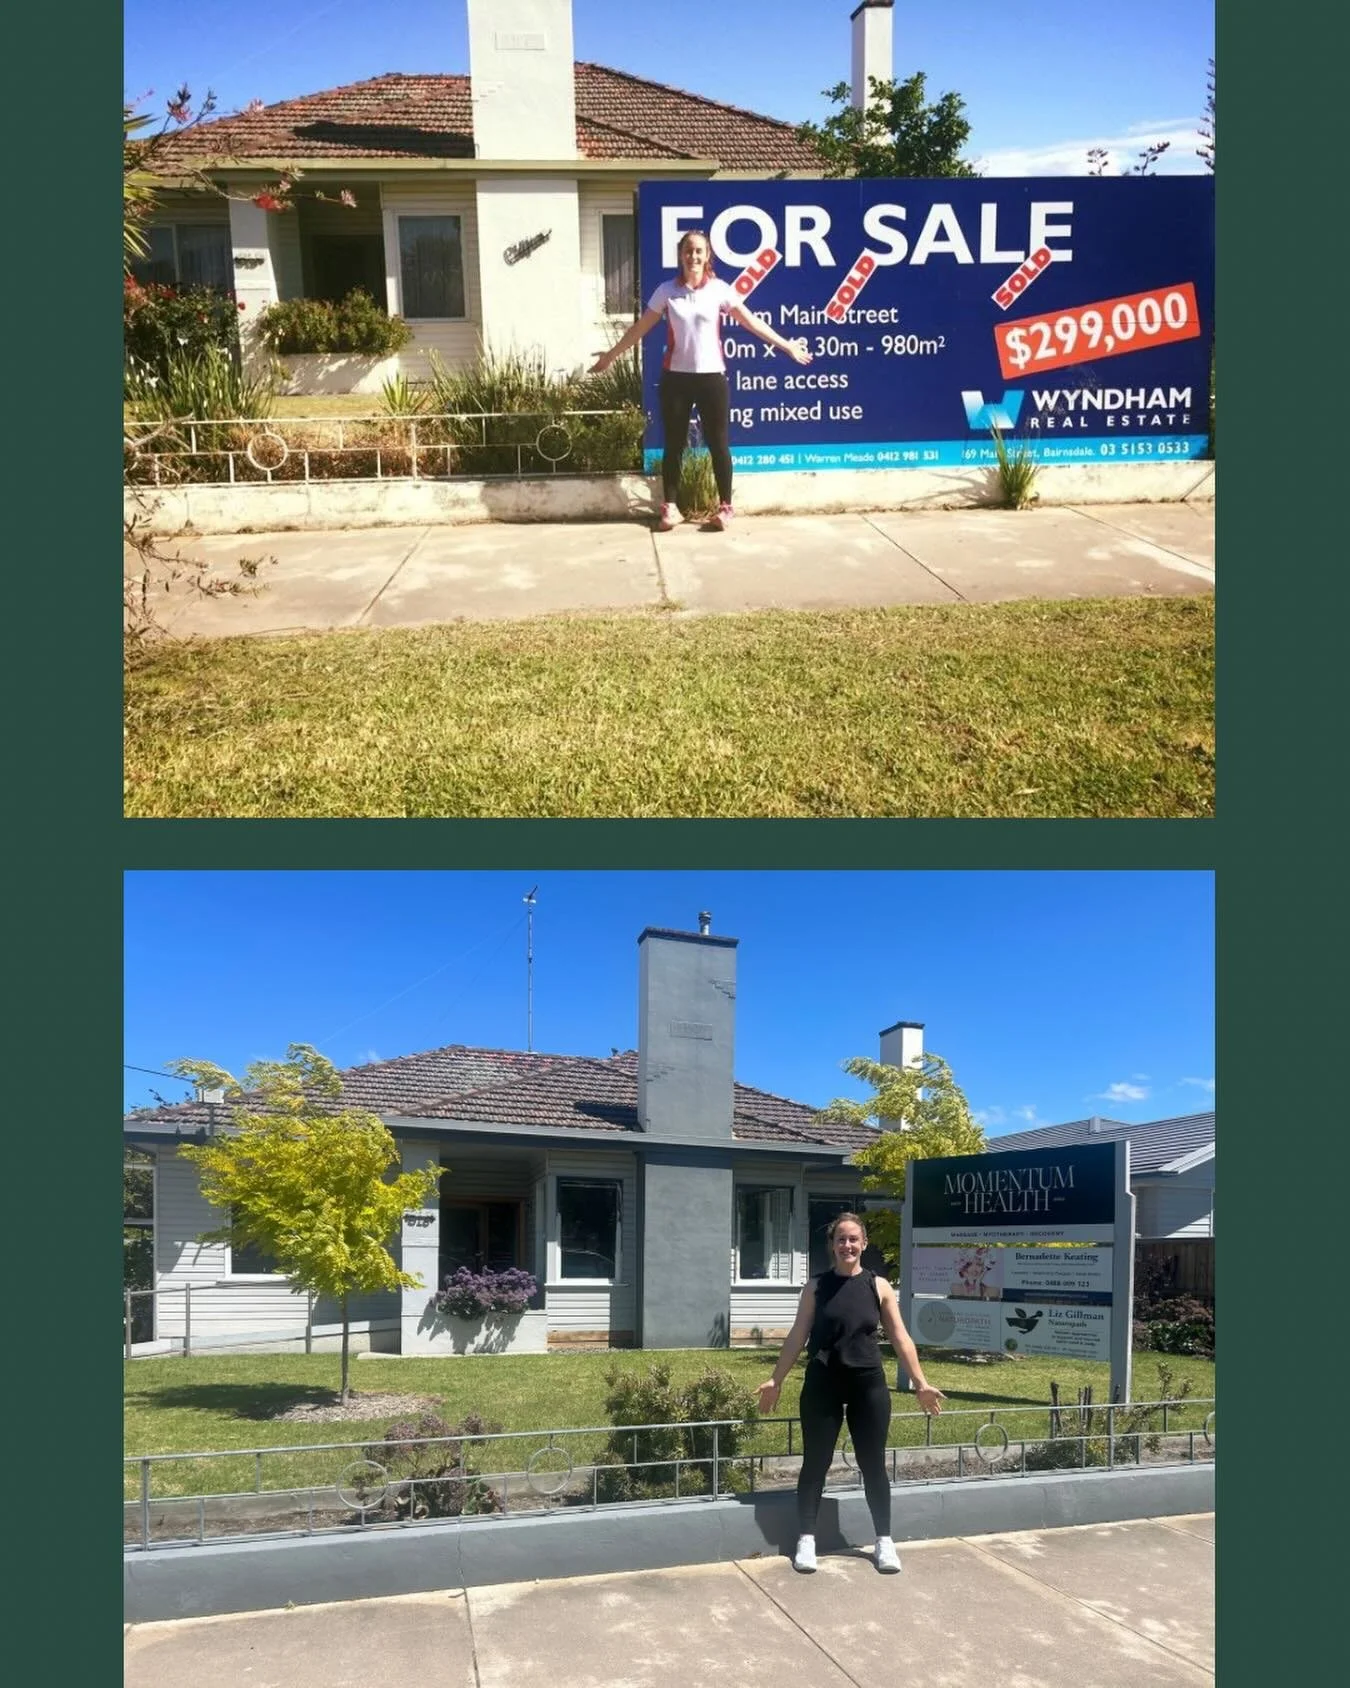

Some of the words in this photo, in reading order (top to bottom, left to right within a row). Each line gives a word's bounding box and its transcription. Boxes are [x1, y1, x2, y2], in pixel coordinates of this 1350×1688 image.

[660, 204, 837, 269] FOR
[863, 201, 1074, 266] SALE
[734, 247, 778, 296] OLD
[994, 247, 1053, 309] SOLD
[826, 255, 876, 321] SOLD
[780, 303, 829, 325] Main
[1004, 291, 1189, 371] $299,000
[736, 370, 777, 391] lane
[784, 374, 849, 390] access
[760, 400, 821, 421] mixed
[829, 405, 863, 420] use
[1032, 387, 1192, 412] WYNDHAM
[1031, 417, 1089, 429] REAL
[1106, 414, 1191, 426] ESTATE
[757, 455, 775, 465] 280
[1100, 443, 1116, 456] 03
[1121, 441, 1153, 455] 5153
[1157, 441, 1190, 454] 0533
[944, 1165, 1075, 1194] MOMENTUM
[964, 1189, 1051, 1214] HEALTH
[1015, 1252, 1060, 1261] Bernadette
[1063, 1252, 1099, 1263] Keating
[1048, 1308, 1063, 1318] Liz
[1065, 1310, 1105, 1321] Gillman
